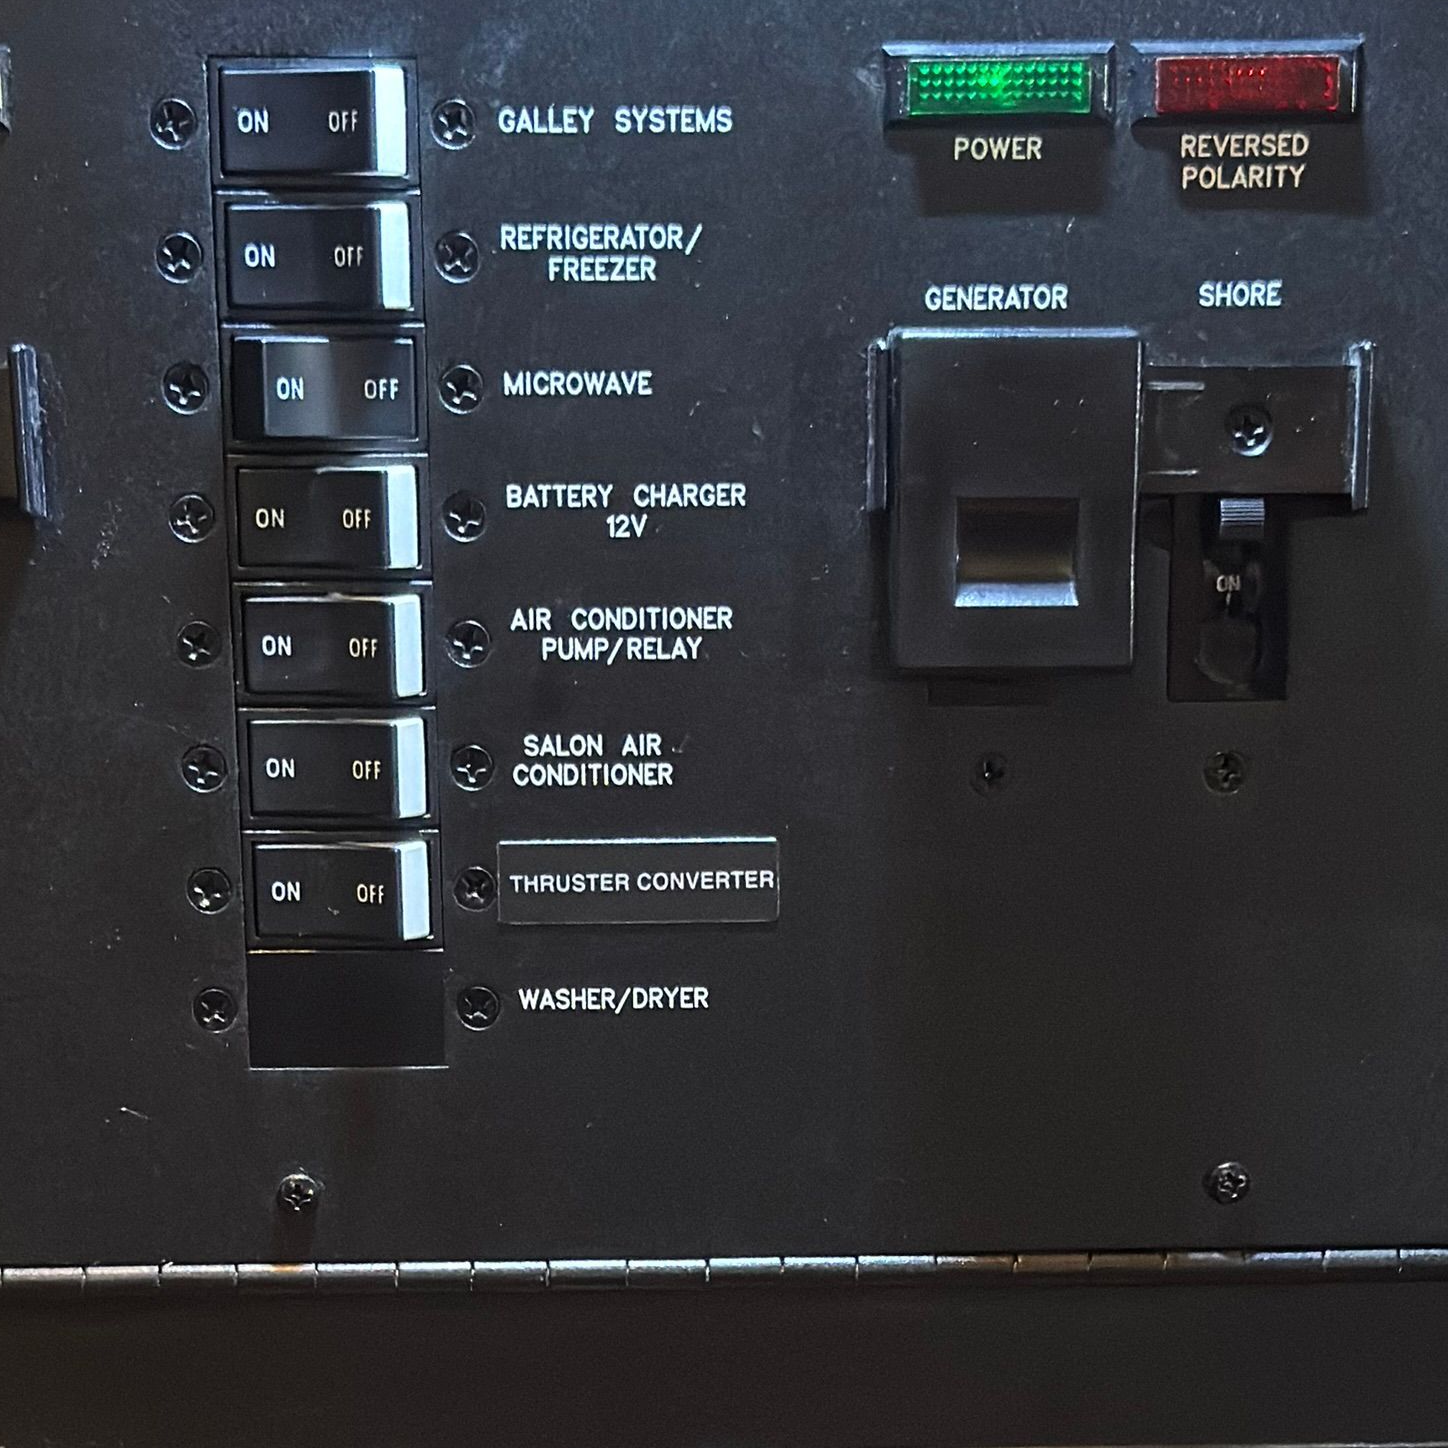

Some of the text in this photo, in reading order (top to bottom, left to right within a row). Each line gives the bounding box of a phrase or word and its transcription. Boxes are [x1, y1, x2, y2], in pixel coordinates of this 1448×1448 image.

[236, 110, 358, 134] ON OFF
[499, 104, 732, 133] GALLEY SYSTEMS
[955, 137, 1042, 160] POWER
[1181, 133, 1309, 157] REVERSED
[1183, 164, 1304, 189] POLARITY
[501, 223, 702, 255] REFRIGERATOR/
[549, 255, 656, 281] FREEZER
[925, 284, 1068, 310] GENERATOR
[1200, 280, 1282, 306] SHORE
[504, 371, 652, 395] MICROWAVE
[506, 483, 746, 508] BATTERY CHARGER
[607, 514, 647, 537] 12V
[511, 606, 732, 630] AIR CONDITIONER
[542, 636, 702, 665] PUMP/RELAY
[524, 733, 661, 756] SALON AIR
[513, 763, 673, 786] CONDITIONER
[510, 870, 773, 893] THRUSTER CONVERTER
[519, 987, 708, 1014] WASHER/DRYER
